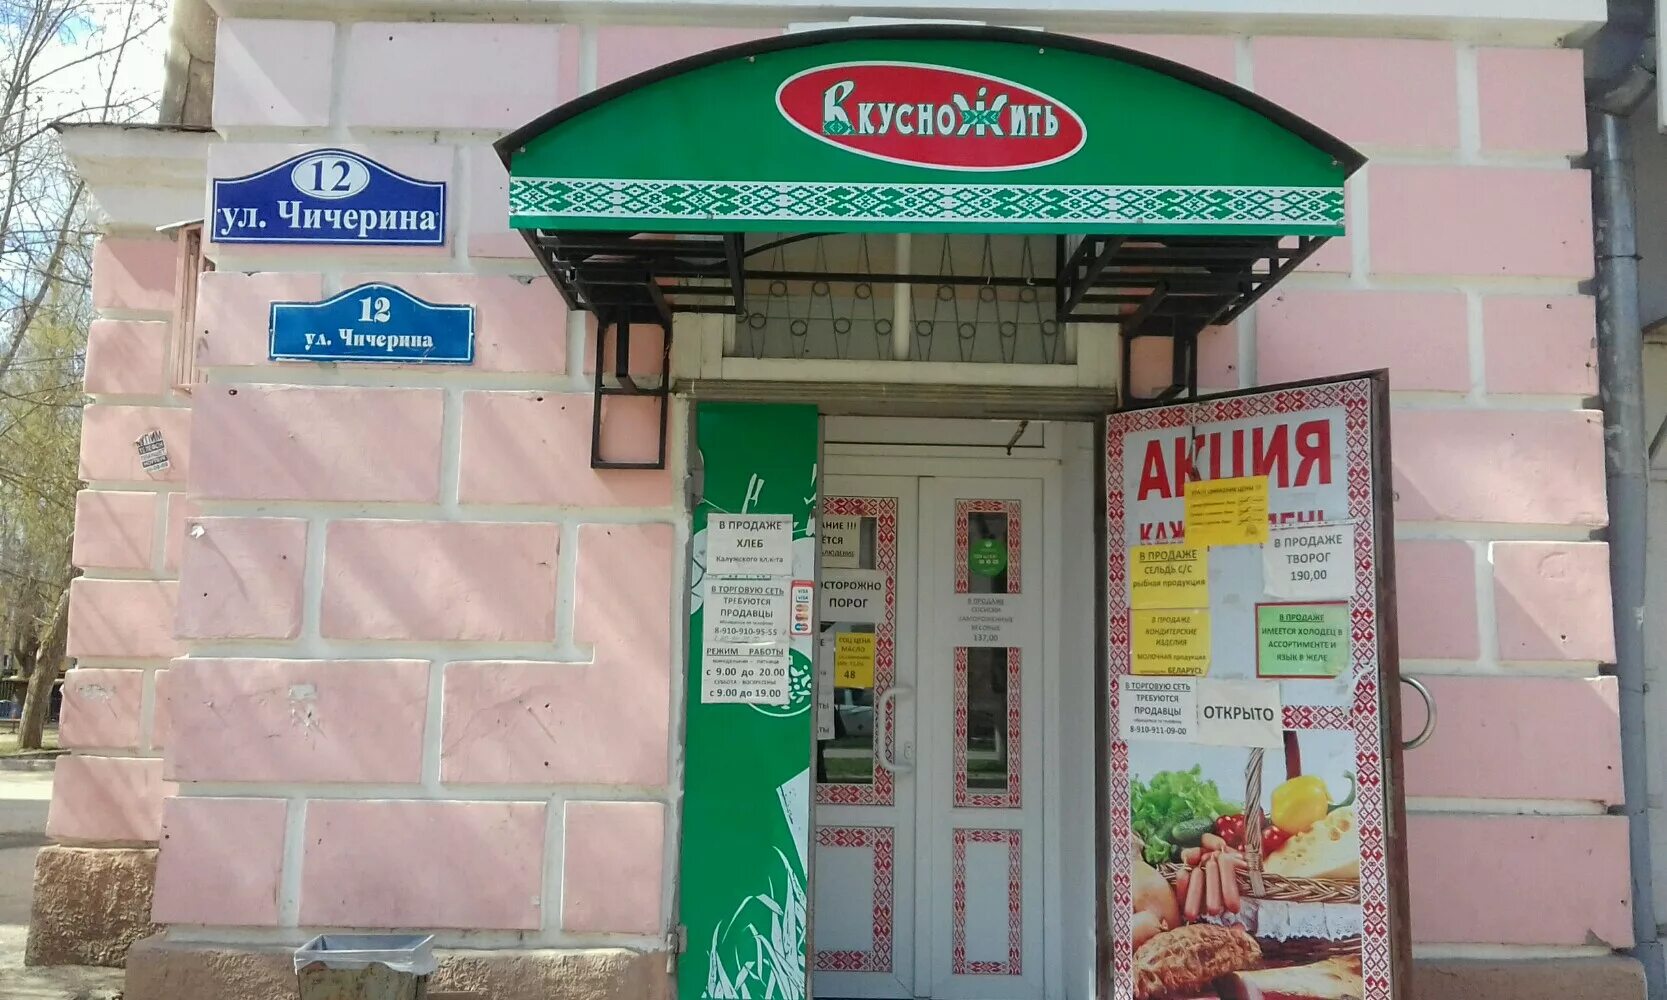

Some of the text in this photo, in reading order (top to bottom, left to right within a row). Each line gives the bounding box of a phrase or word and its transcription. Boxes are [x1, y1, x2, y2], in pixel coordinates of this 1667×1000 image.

[310, 160, 352, 192] 12
[220, 200, 437, 237] ул. Чичерина
[358, 296, 391, 323] 12
[304, 329, 434, 351] ул. Чичерина
[1137, 419, 1332, 500] АКЦИЯ
[719, 521, 783, 532] В ПРОДАЖЕ
[736, 538, 764, 548] ХЛЕБ
[1274, 534, 1343, 548] В ПРОДАЖЕ
[1140, 549, 1198, 562] В ПРОДАЖЕ
[1286, 552, 1331, 564] ТВОРОГ
[1144, 565, 1193, 575] СЕЛЬДЬ С/С
[1290, 569, 1328, 582] 190,00
[1133, 579, 1206, 588] рыбная продукция
[765, 587, 785, 595] СЕТЬ
[723, 597, 771, 605] ТРЕБУЮТСЯ
[829, 598, 869, 608] ПОРОГ
[720, 609, 773, 619] ПРОДАВЦЫ
[1279, 613, 1325, 622] В ПРОДАЖЕ
[1157, 616, 1191, 624] ПРОДАЖЕ
[714, 627, 778, 636] 8-910-910-95-55
[1145, 628, 1198, 636] КОНДИТЕРСКИЕ
[1261, 627, 1343, 637] ИМЕЕТСЯ ХОЛОДЕЦ В
[973, 634, 999, 643] 137,00
[1155, 639, 1187, 647] ИЗДЕЛИЯ
[1268, 640, 1337, 649] АССОРТИМЕНТЕ И
[749, 648, 784, 656] РАБОТЫ
[1276, 654, 1328, 662] ЯЗЫК В ЖЕЛЕ
[715, 667, 737, 676] 9.00
[741, 669, 754, 677] до
[760, 668, 785, 677] 20.00
[843, 670, 856, 679] 48
[1167, 667, 1203, 675] БЕЛАРУСЬ
[1125, 682, 1130, 690] В
[1131, 682, 1172, 691] ТОРГОВУЮ
[717, 688, 737, 697] 9.00
[740, 690, 753, 698] до
[755, 689, 781, 698] 19.00
[1136, 694, 1179, 703] ТРЕБУЮТСЯ
[1134, 706, 1182, 716] ПРОДАВЦЫ
[1203, 705, 1275, 722] ОТКРЫТО
[1129, 725, 1187, 735] 8-910-911-09-00
